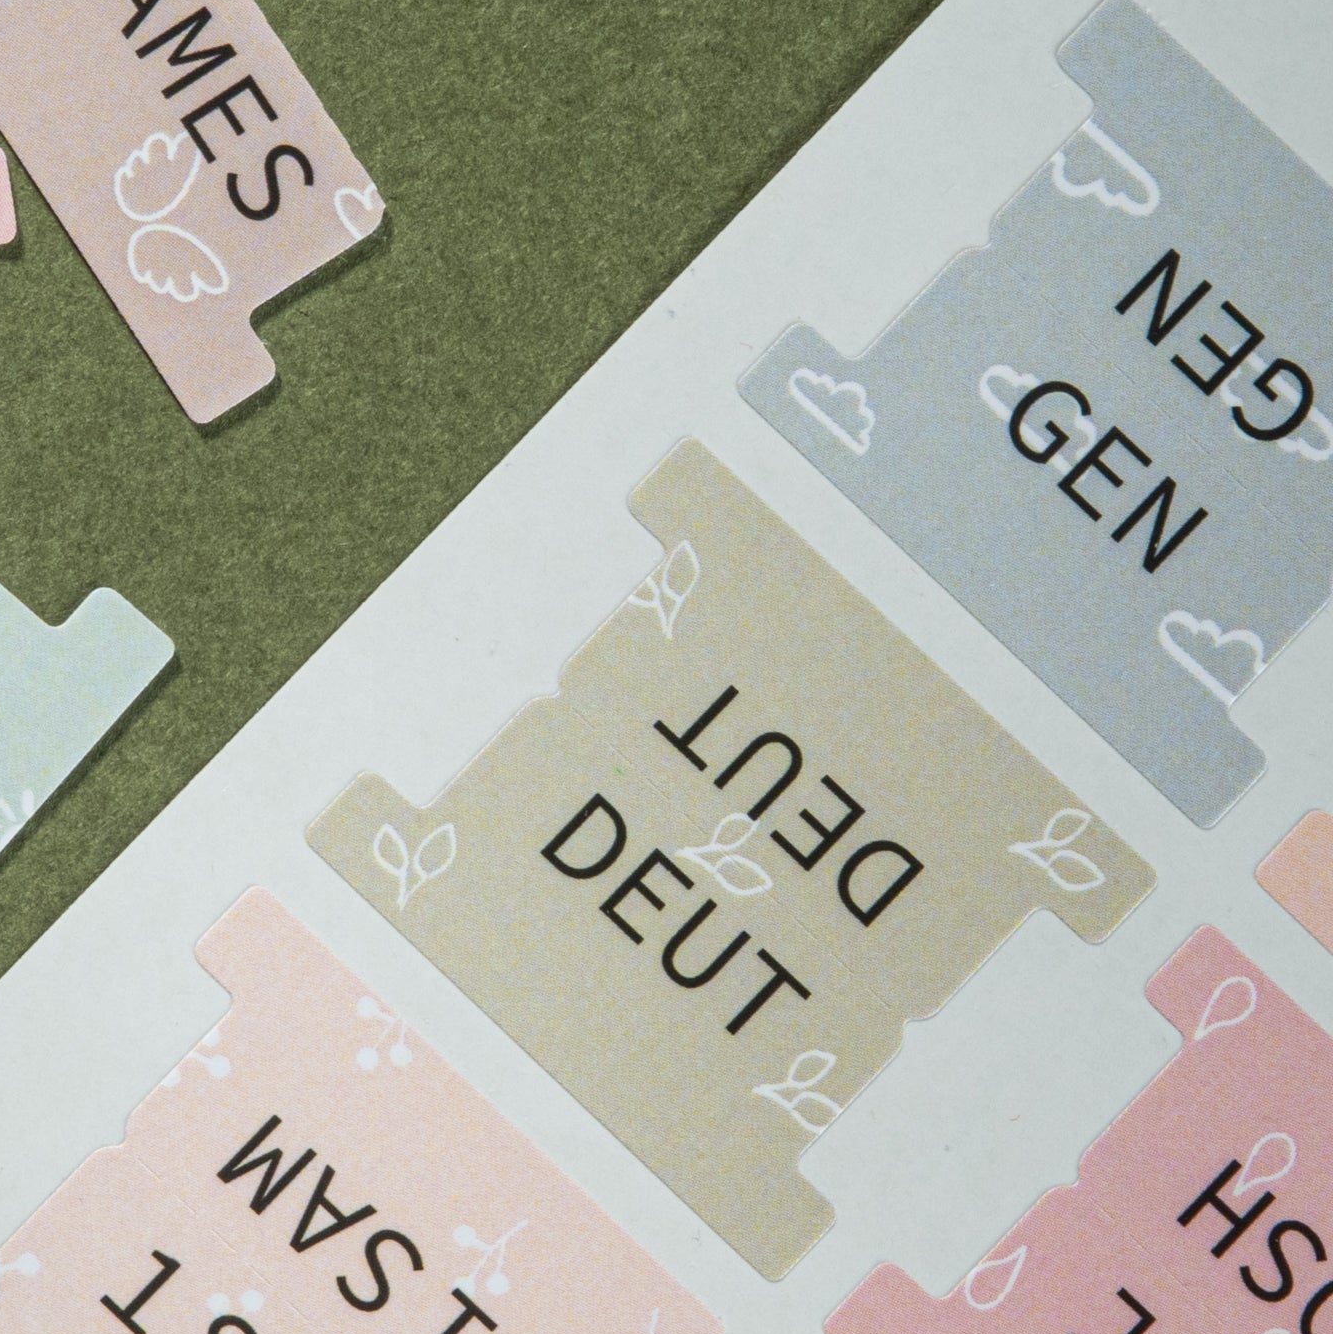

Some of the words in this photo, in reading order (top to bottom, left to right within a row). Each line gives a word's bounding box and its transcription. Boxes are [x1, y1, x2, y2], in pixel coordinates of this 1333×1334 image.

[1114, 248, 1314, 442] GEN
[1008, 380, 1209, 574] GEN
[653, 685, 925, 928] DEUT
[540, 793, 812, 1036] DEUT
[217, 1115, 424, 1312] SAM
